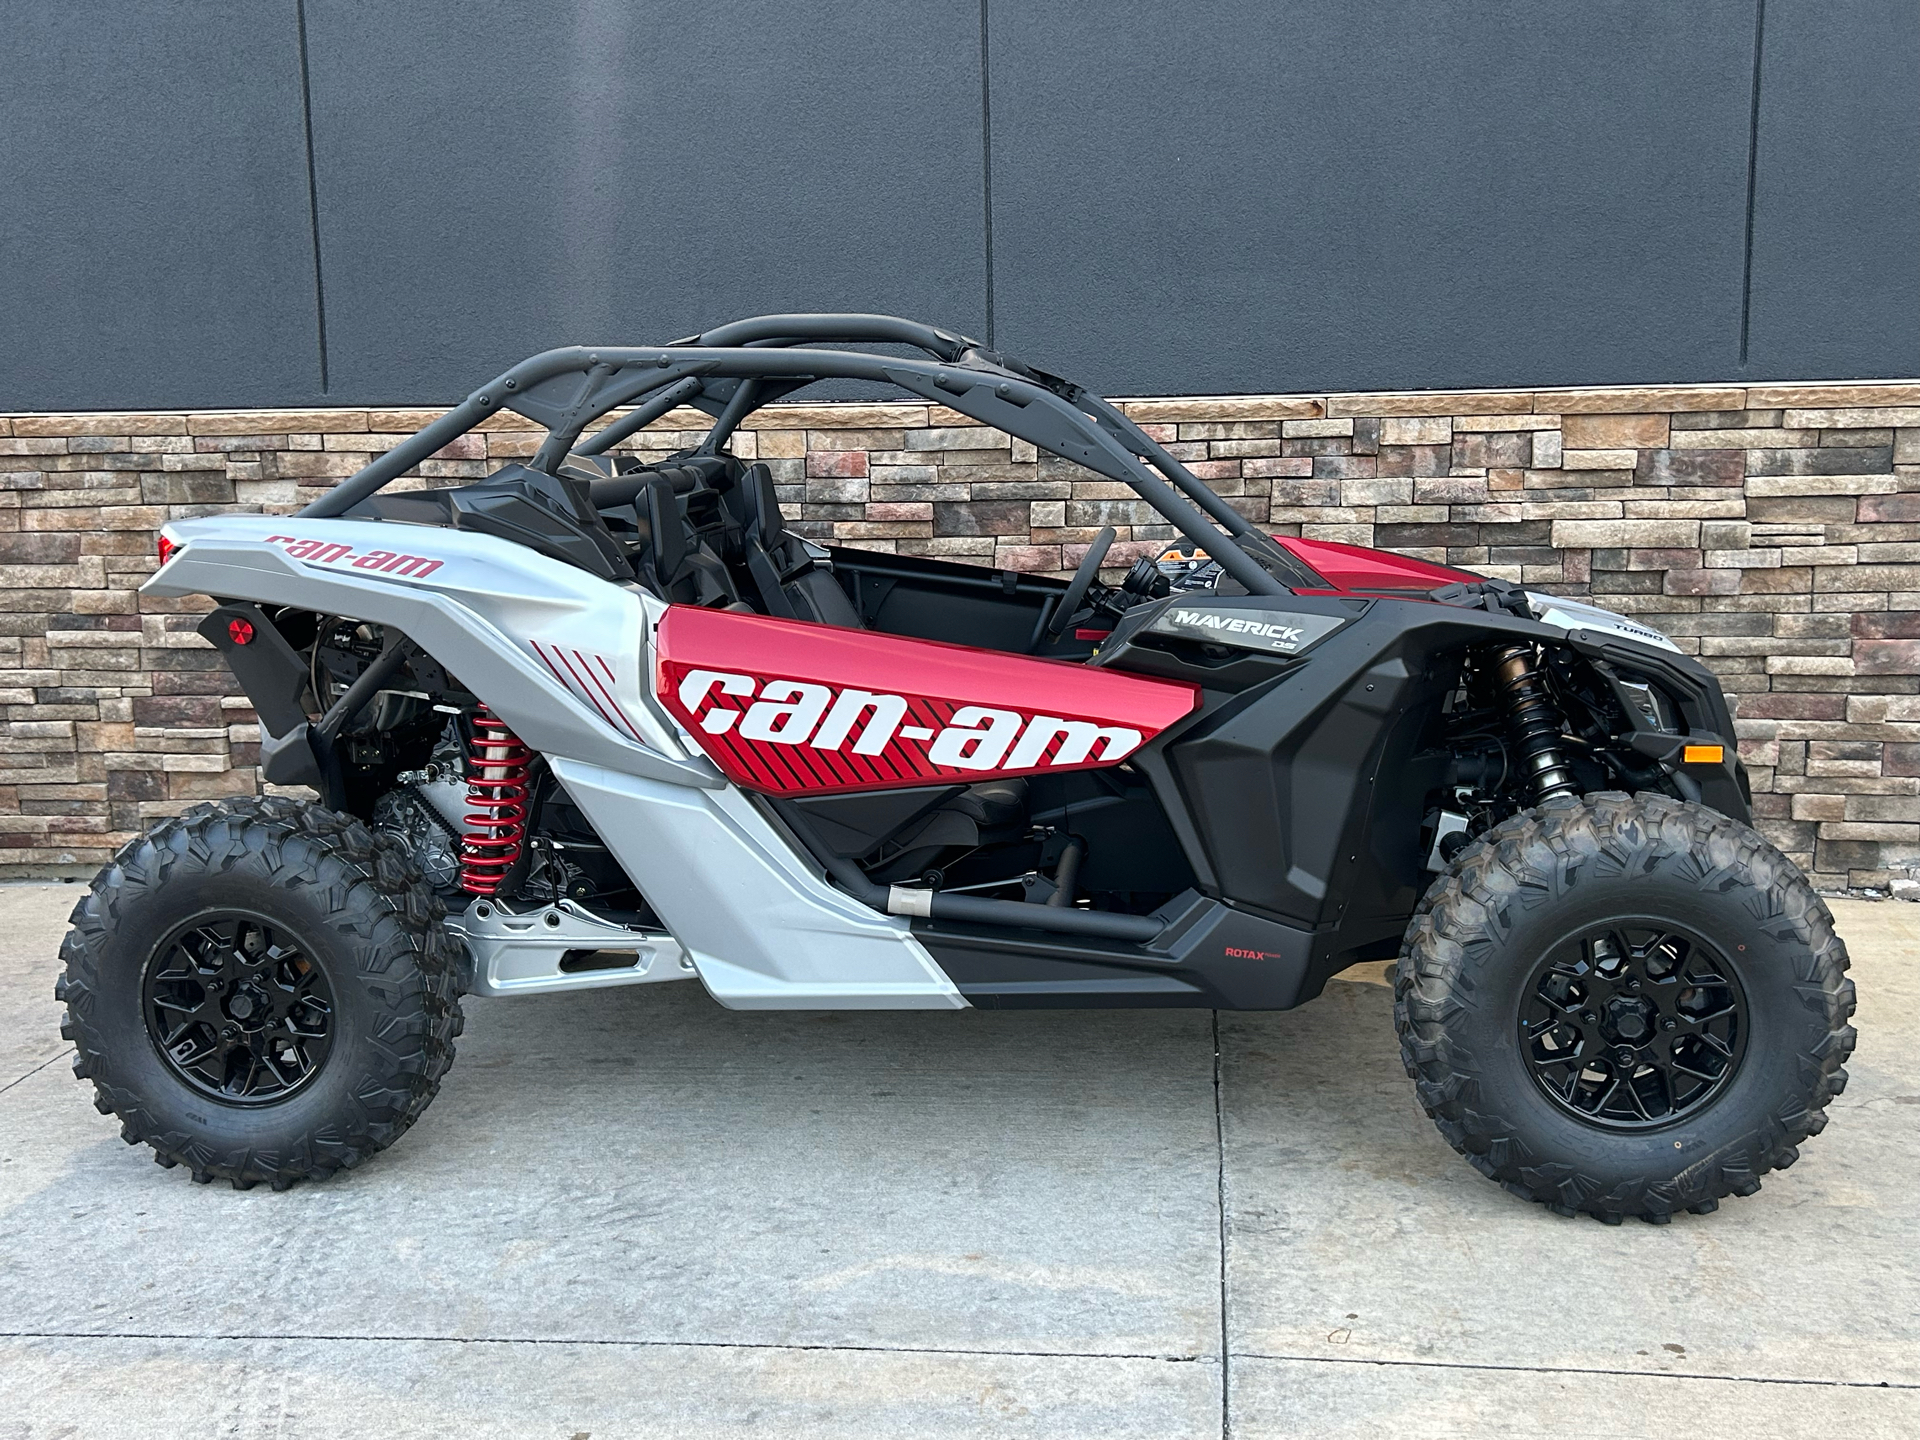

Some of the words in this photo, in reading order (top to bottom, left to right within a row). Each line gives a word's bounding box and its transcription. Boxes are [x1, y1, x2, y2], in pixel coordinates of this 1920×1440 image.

[1174, 611, 1305, 641] MAVERICK
[1614, 623, 1664, 641] TURBO
[1271, 640, 1298, 650] DS
[678, 669, 1142, 771] can-am
[1225, 947, 1265, 961] ROTAX
